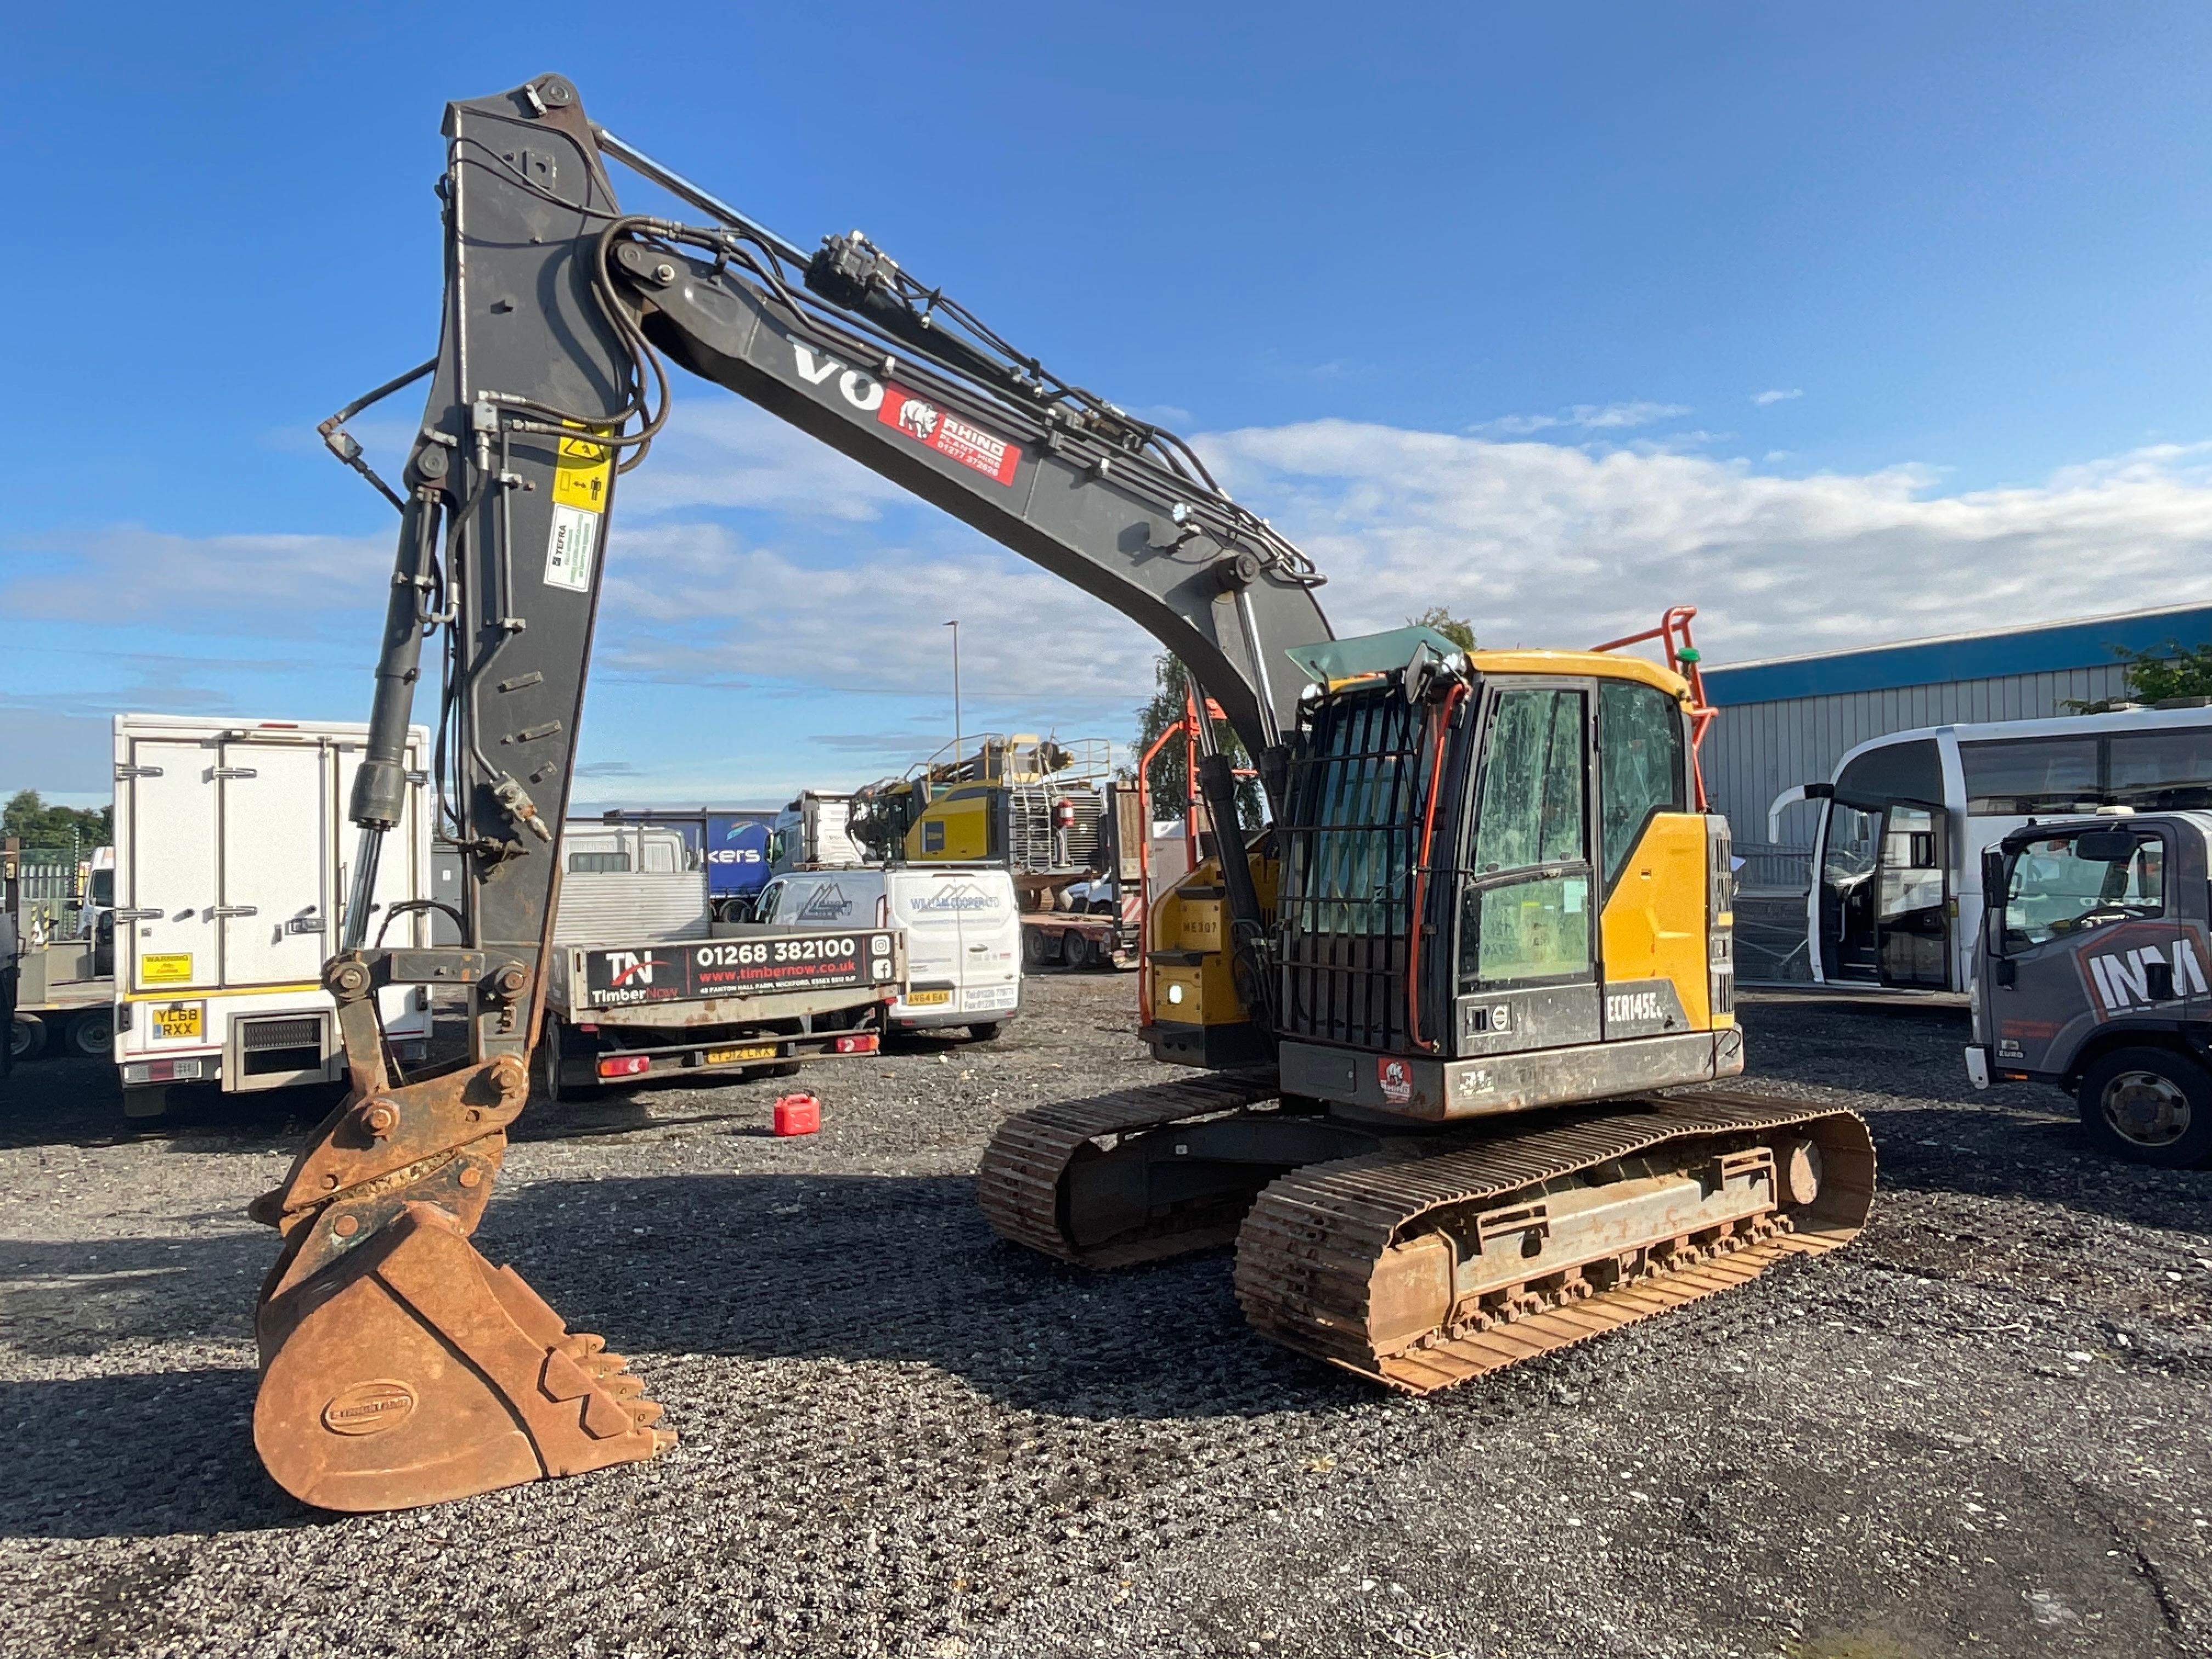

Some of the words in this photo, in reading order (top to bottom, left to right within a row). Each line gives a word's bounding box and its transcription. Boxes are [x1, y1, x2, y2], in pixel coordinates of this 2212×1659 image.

[939, 433, 973, 453] PLANT
[944, 418, 1005, 456] RHINO
[937, 441, 966, 459] 01277
[556, 524, 567, 554] TEFRA
[697, 944, 768, 967] 01268
[775, 939, 855, 961] 382100
[606, 950, 653, 985] TN
[698, 959, 856, 983] www.timbernow.co.uk
[592, 986, 679, 1003] TimberNow
[163, 1023, 193, 1035] RXX
